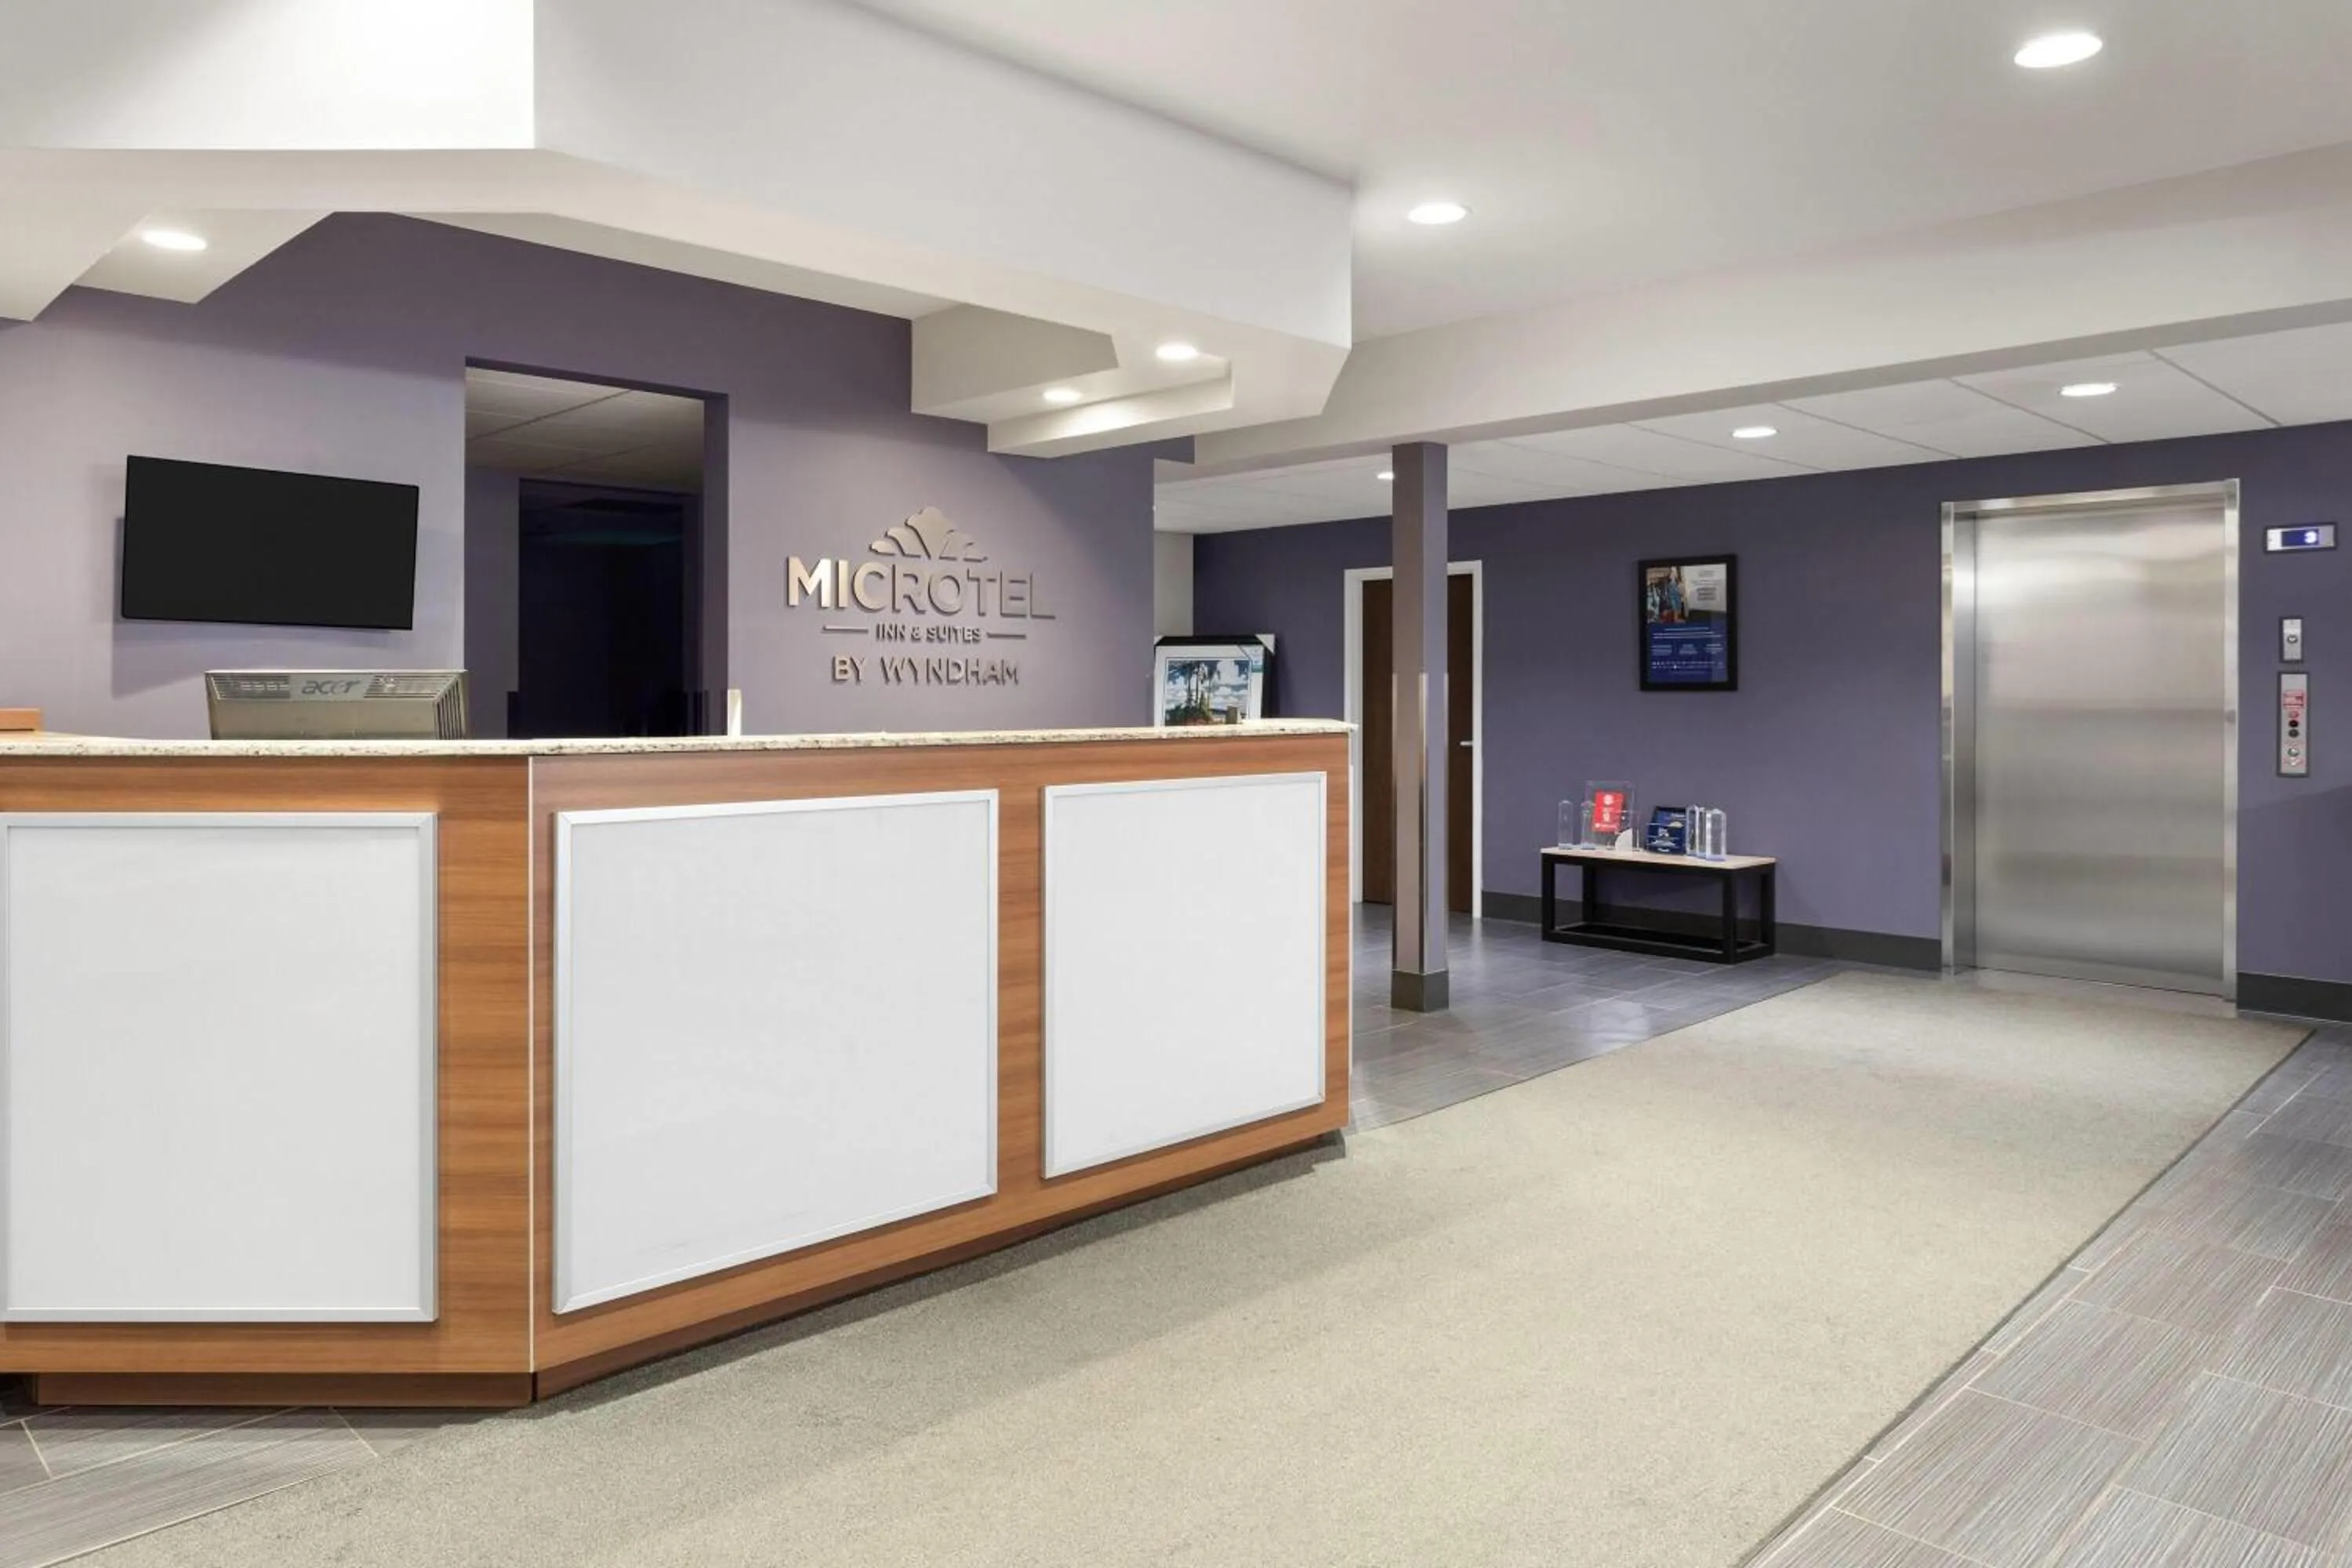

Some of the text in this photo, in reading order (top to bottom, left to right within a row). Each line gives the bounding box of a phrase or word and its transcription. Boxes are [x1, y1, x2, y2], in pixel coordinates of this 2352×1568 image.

[786, 556, 1056, 619] MICROTEL
[876, 622, 981, 644] INN & SUITES
[832, 655, 1019, 686] BY WYNDHAM
[301, 680, 361, 695] acer
